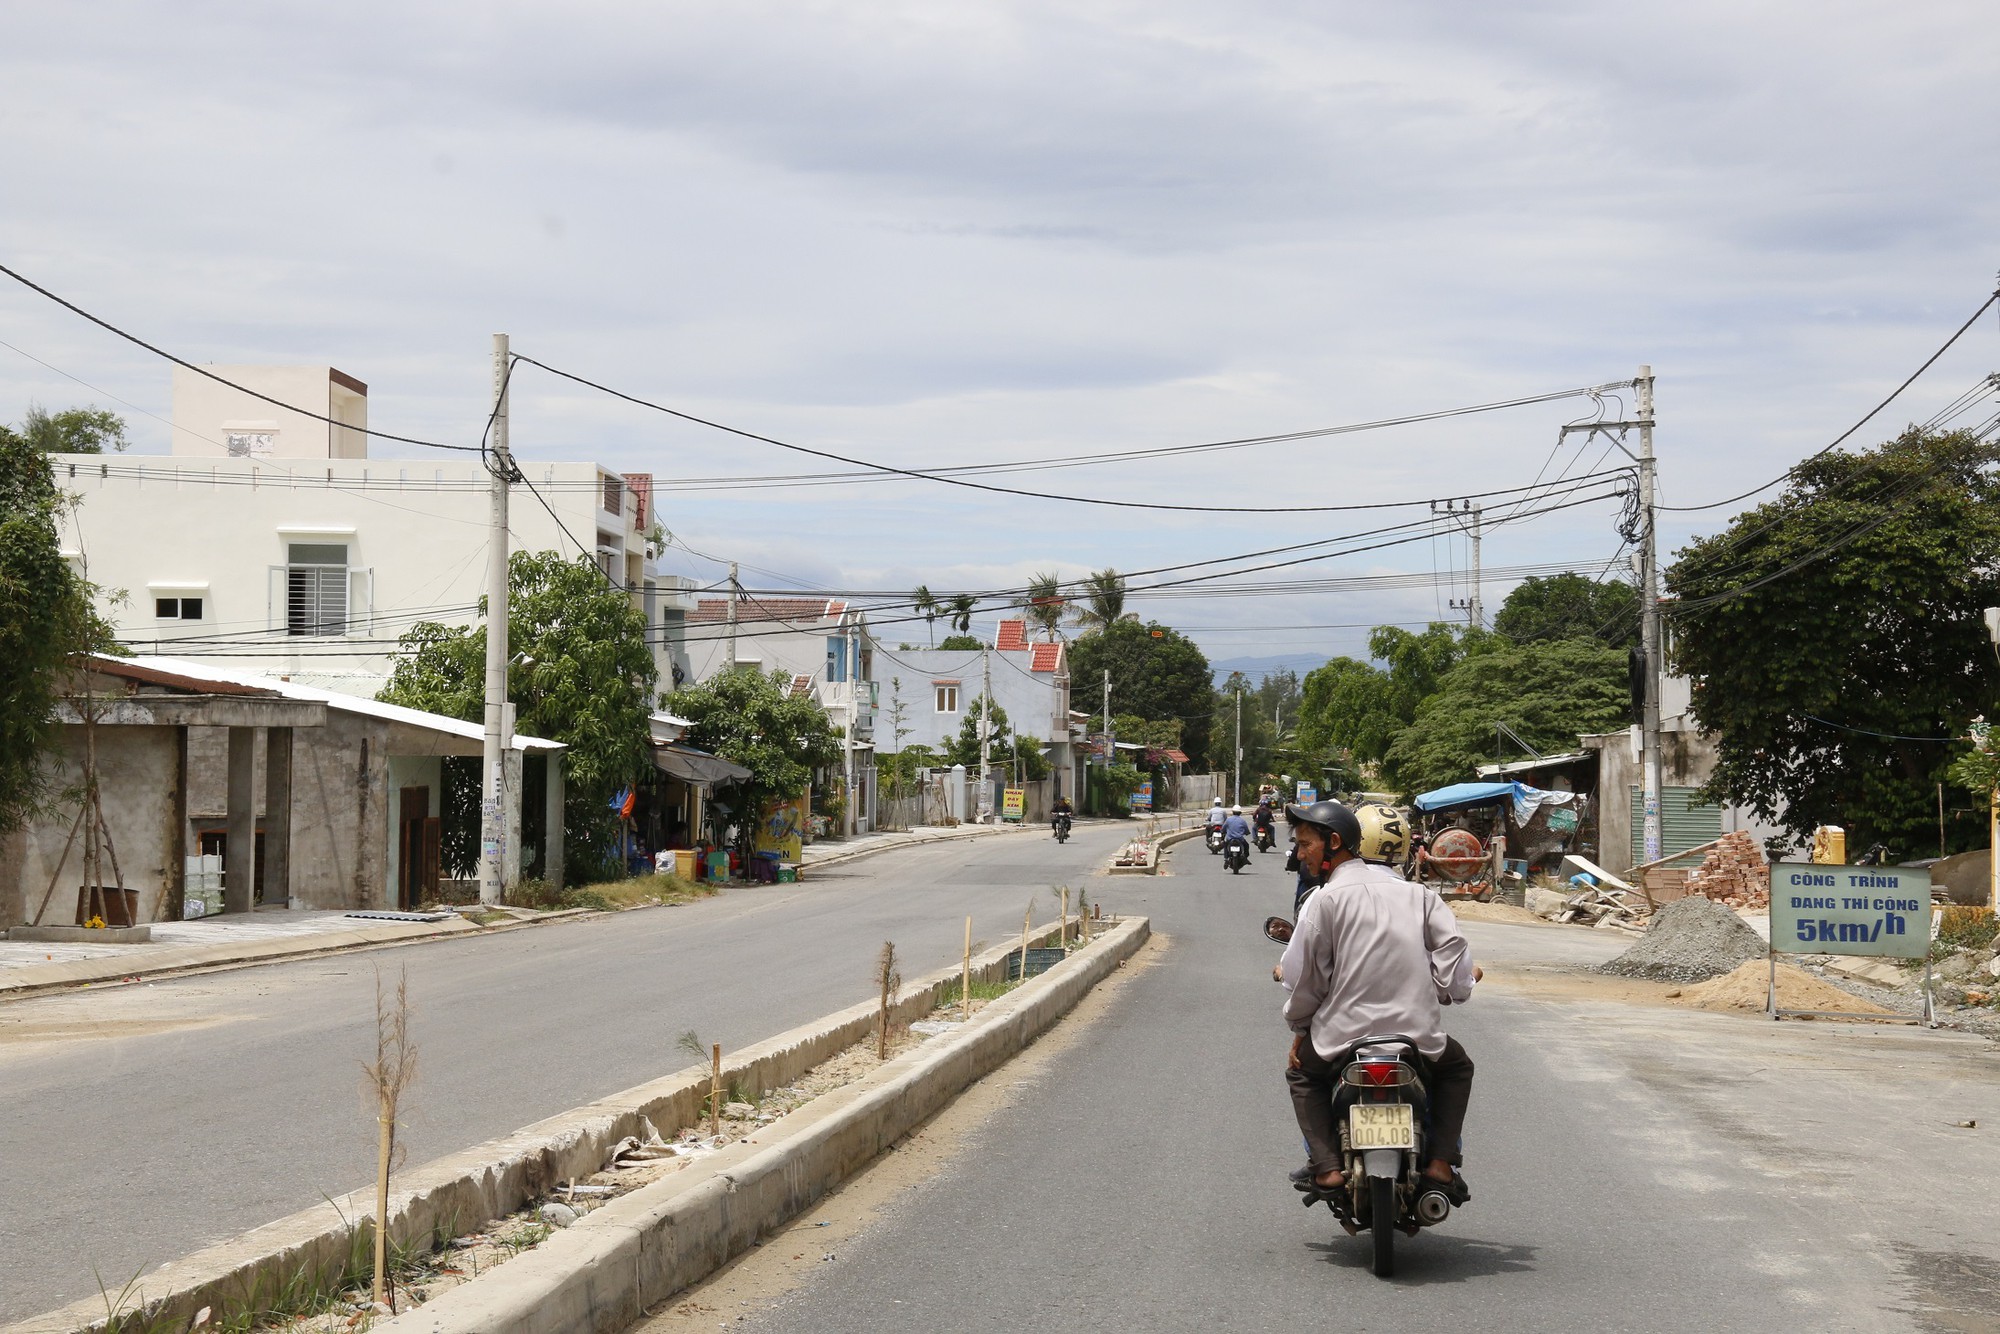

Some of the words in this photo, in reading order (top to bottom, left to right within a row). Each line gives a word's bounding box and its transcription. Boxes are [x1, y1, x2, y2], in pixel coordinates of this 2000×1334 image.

[1790, 872, 1835, 887] CÔNG
[1848, 870, 1898, 888] TRÌNH
[1791, 896, 1836, 910] ĐANG
[1873, 896, 1919, 911] CÔNG
[1796, 912, 1905, 942] 5km/h
